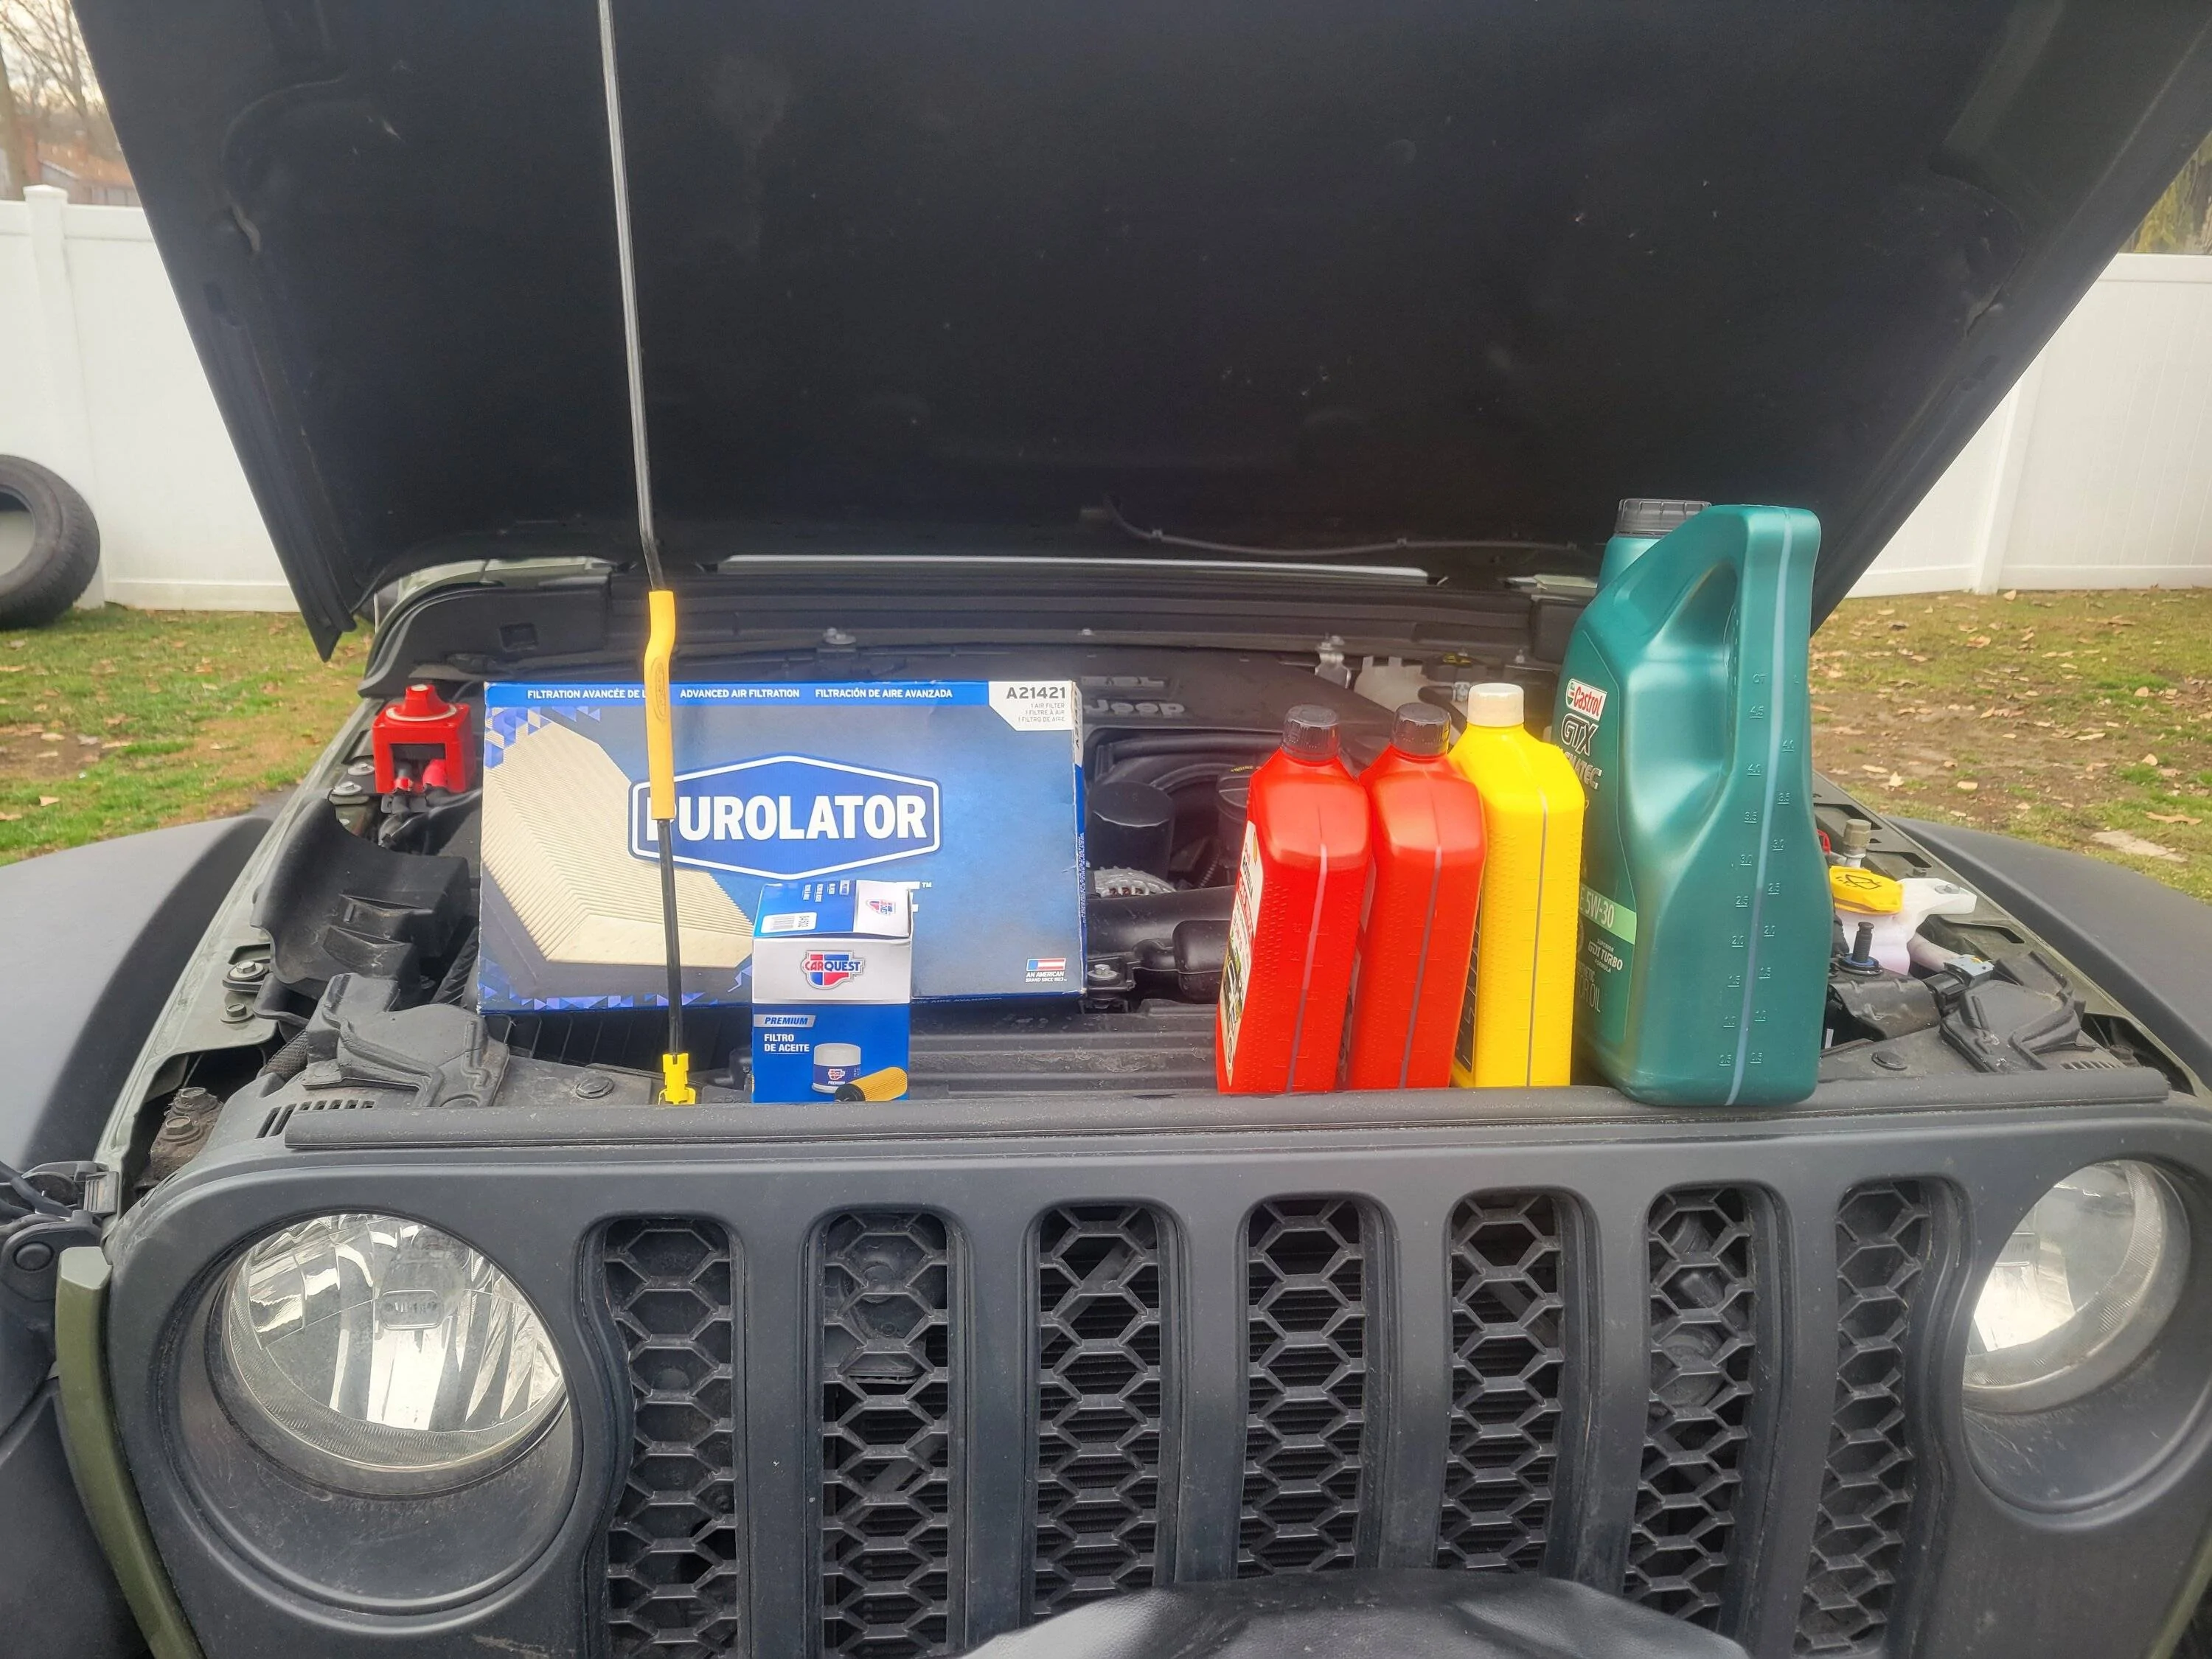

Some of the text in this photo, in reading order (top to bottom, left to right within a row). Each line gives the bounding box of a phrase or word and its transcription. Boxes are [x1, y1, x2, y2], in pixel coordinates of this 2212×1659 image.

[527, 689, 580, 699] FILTRATION
[582, 688, 625, 698] AVANCÉE
[627, 689, 640, 698] DE
[680, 689, 800, 698] ADVANCED AIR FILTRATION
[815, 688, 953, 698] FILTRACIÓN DE AIRE AVANZADA
[1006, 686, 1065, 699] A21421
[1573, 686, 1603, 717] Castrol
[1084, 700, 1185, 717] Jeep
[1750, 706, 1764, 717] 4.5
[1561, 713, 1599, 757] GTX
[1768, 883, 1780, 892] 2.5
[1736, 895, 1748, 905] 2.5
[1585, 892, 1615, 928] 5W-30
[1587, 941, 1623, 970] GDI TURBO
[804, 961, 860, 972] CARQUEST
[1590, 983, 1601, 1012] OIL
[765, 1034, 794, 1042] FILTRO
[765, 1044, 810, 1052] DE ACEITE
